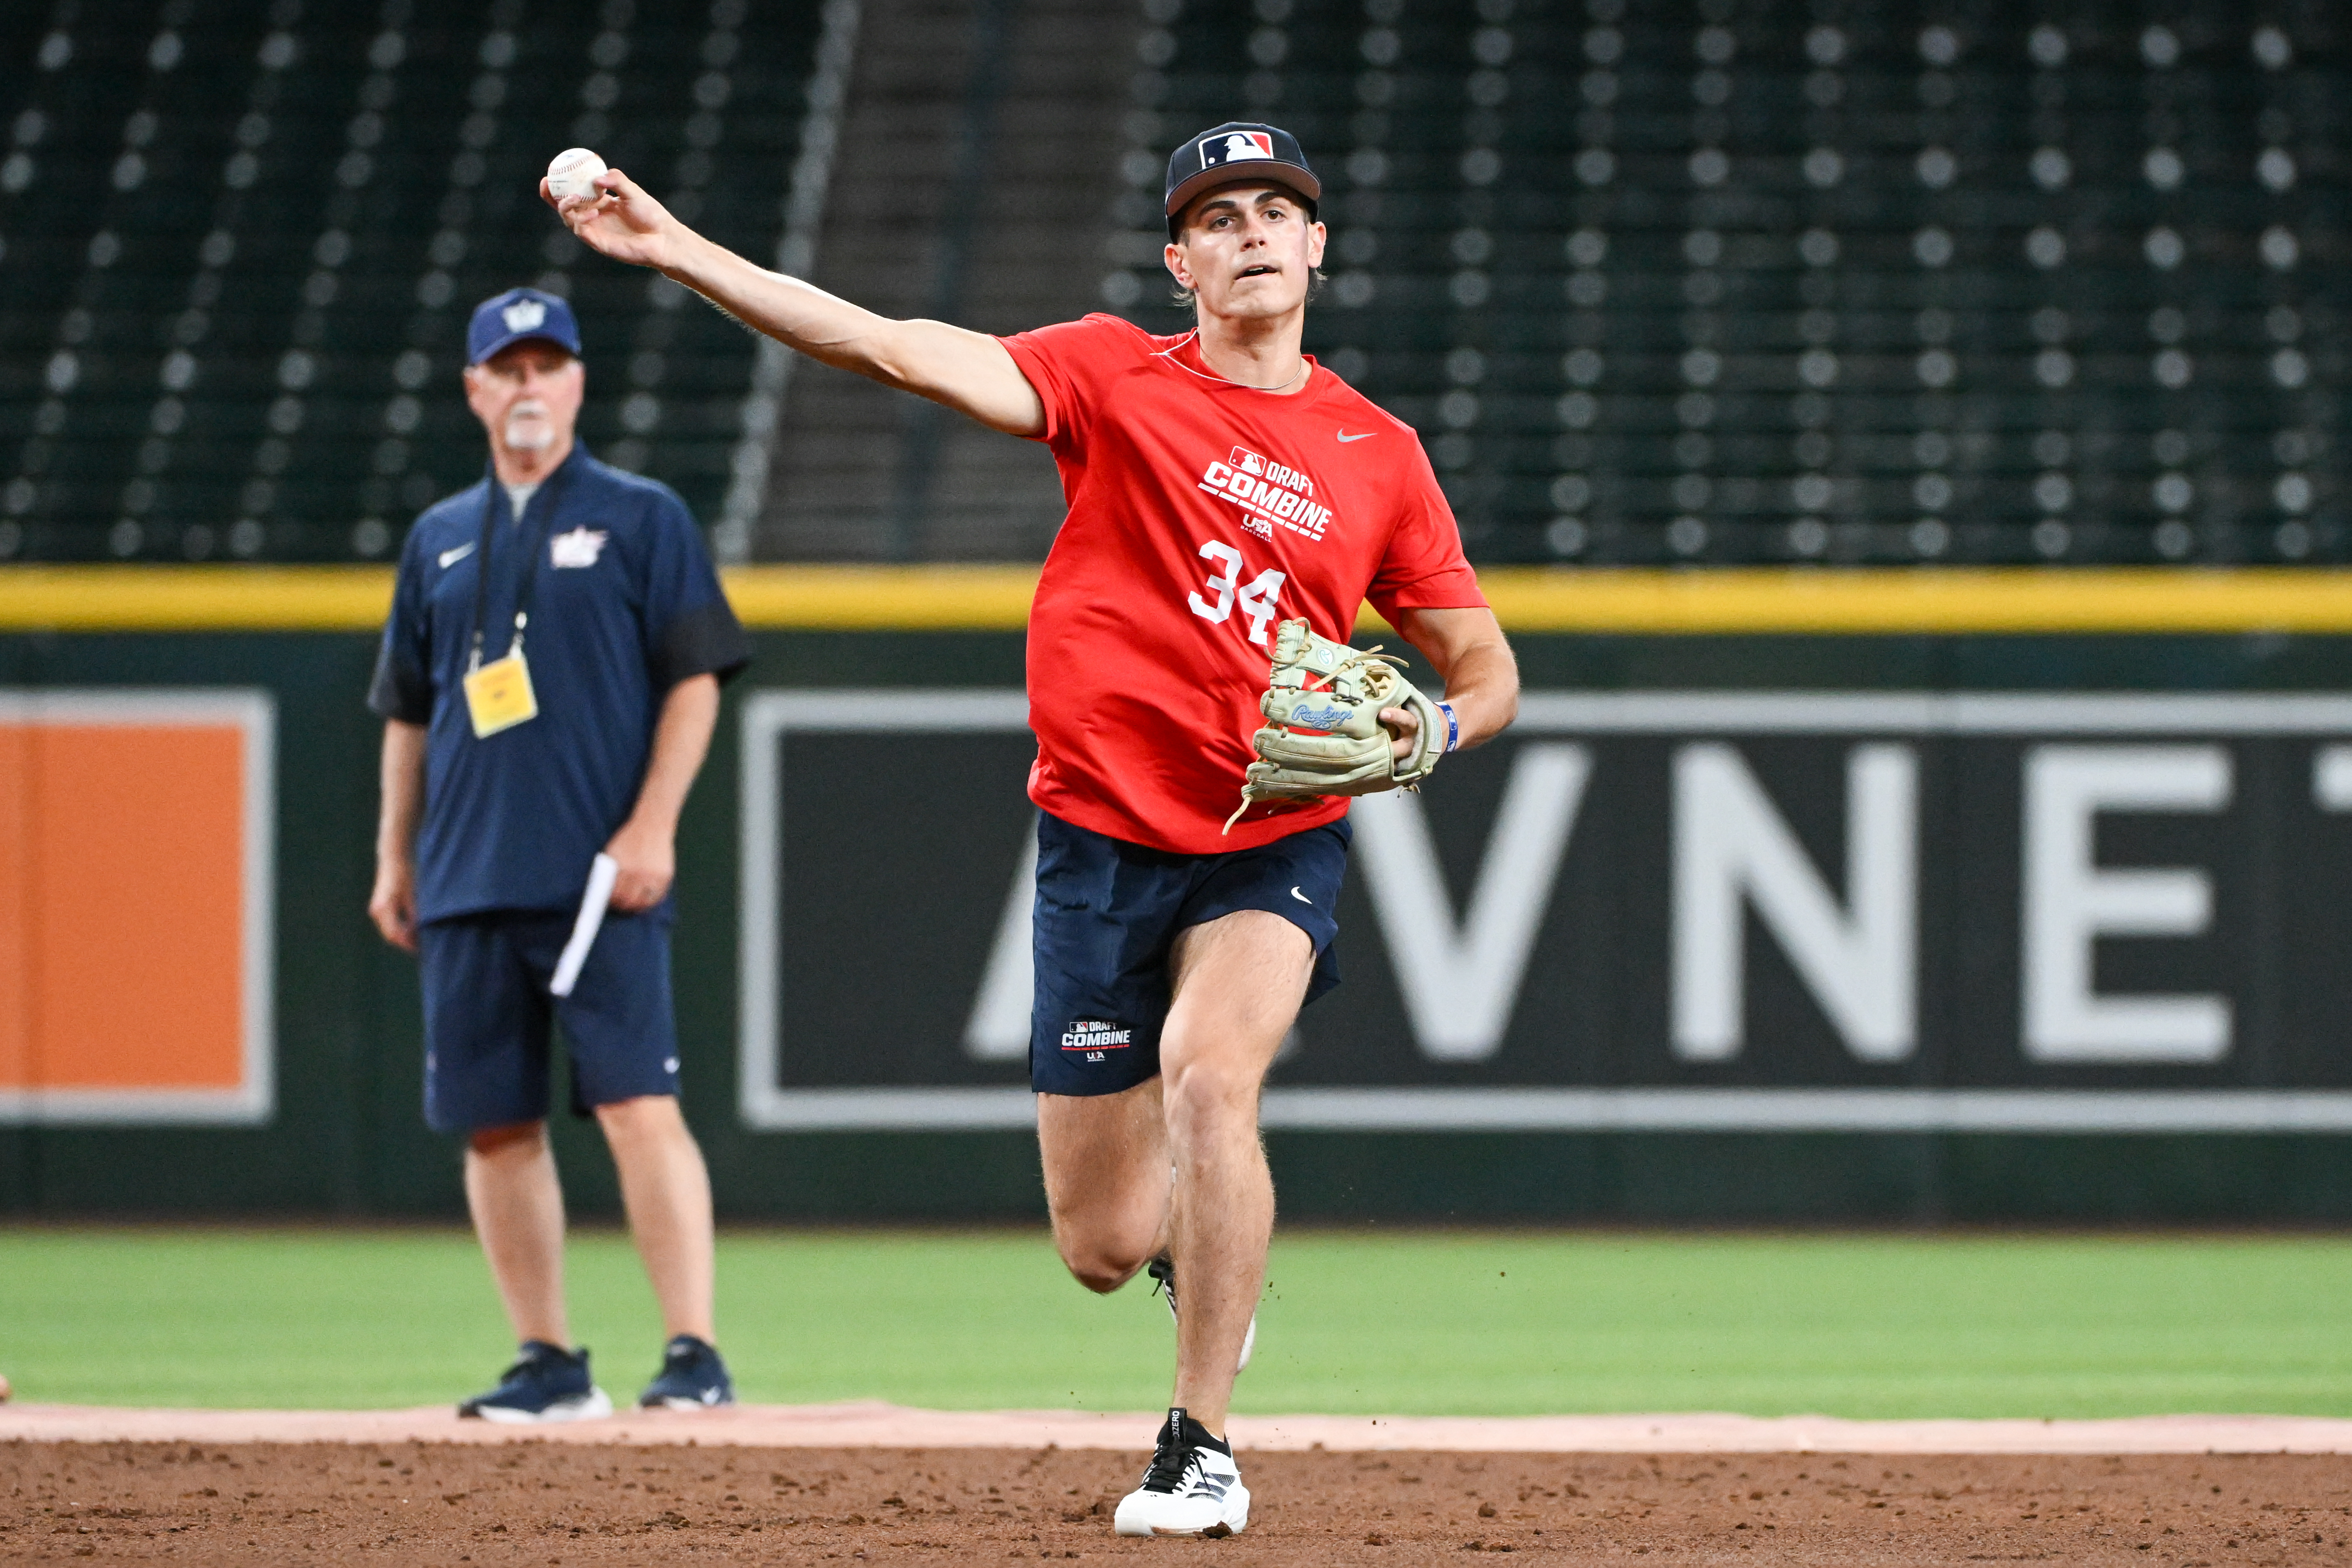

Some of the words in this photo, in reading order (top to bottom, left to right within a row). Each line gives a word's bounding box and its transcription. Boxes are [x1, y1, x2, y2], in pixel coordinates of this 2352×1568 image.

[1265, 461, 1313, 497] DRAFT
[1204, 461, 1332, 534] COMBINE
[1187, 540, 1286, 646] 34
[1292, 704, 1354, 727] Rawlings
[961, 743, 2352, 1062] VNE
[1061, 1030, 1131, 1047] COMBINE
[1089, 1021, 1117, 1032] DRAFT
[1087, 1051, 1105, 1059] UA
